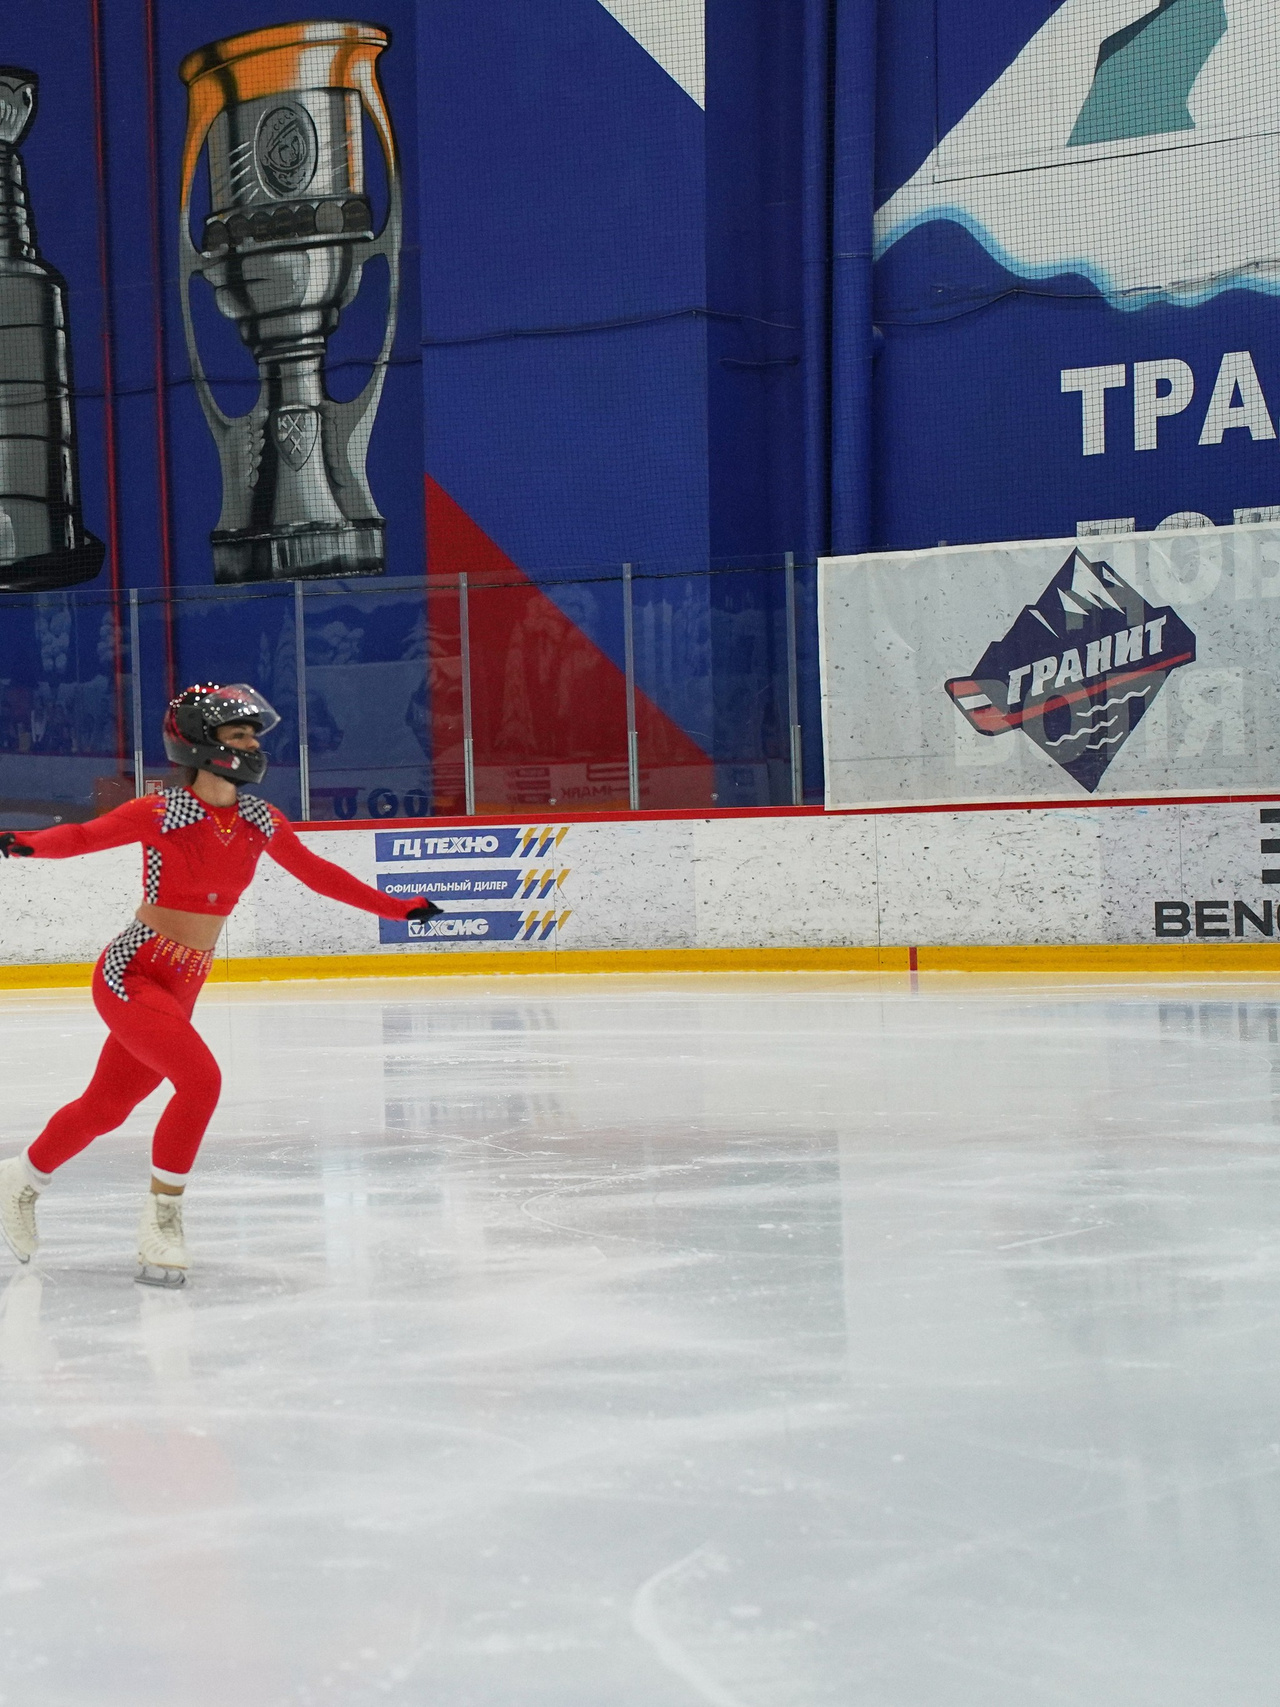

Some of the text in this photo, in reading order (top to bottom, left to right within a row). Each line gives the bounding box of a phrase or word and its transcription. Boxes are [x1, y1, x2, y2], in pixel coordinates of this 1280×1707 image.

[1006, 615, 1167, 705] ГРАНИТ
[392, 836, 499, 857] ГЦ ТЕХНО
[385, 880, 508, 894] ОФИЦИАЛЬНЫЙ ДИЛЕР
[425, 918, 489, 937] XCMG
[1154, 900, 1280, 937] BEN
